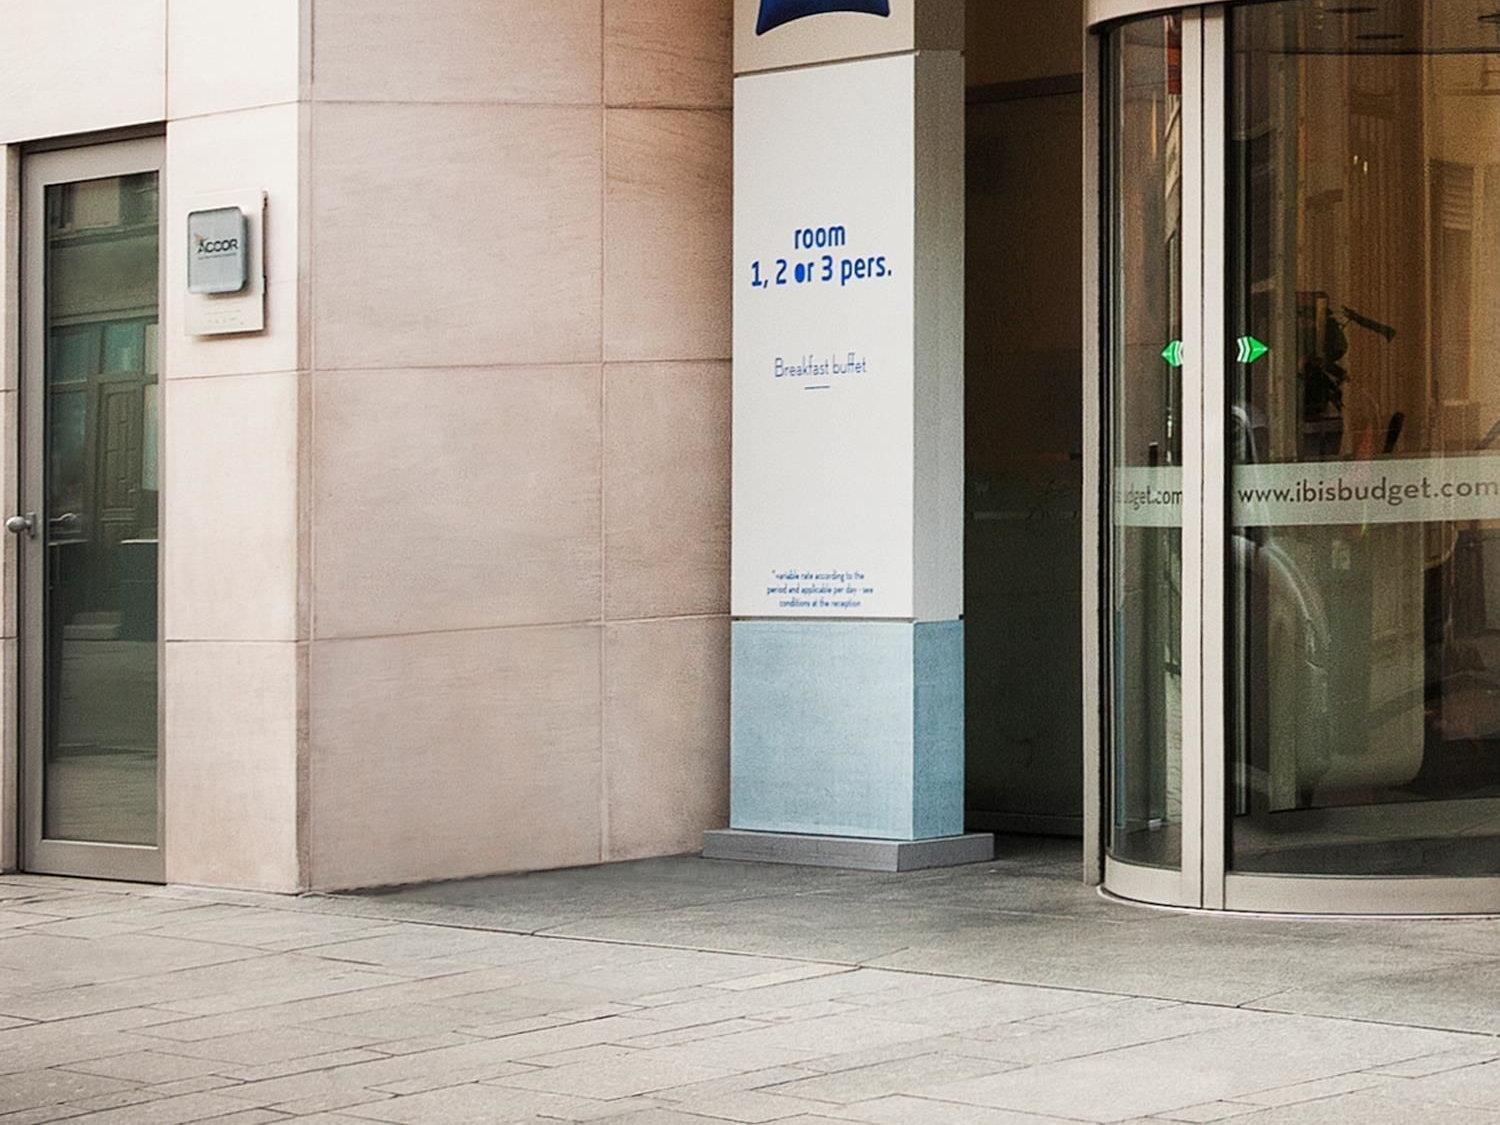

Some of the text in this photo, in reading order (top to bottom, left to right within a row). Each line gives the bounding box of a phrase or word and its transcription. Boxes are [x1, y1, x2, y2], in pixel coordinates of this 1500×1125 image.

[196, 238, 239, 254] ACCOR
[794, 225, 846, 250] room
[751, 255, 892, 288] 1, 2 or 3 pers.
[775, 351, 867, 377] Breakfast buffet
[1238, 477, 1499, 506] www.ibisbudget.com
